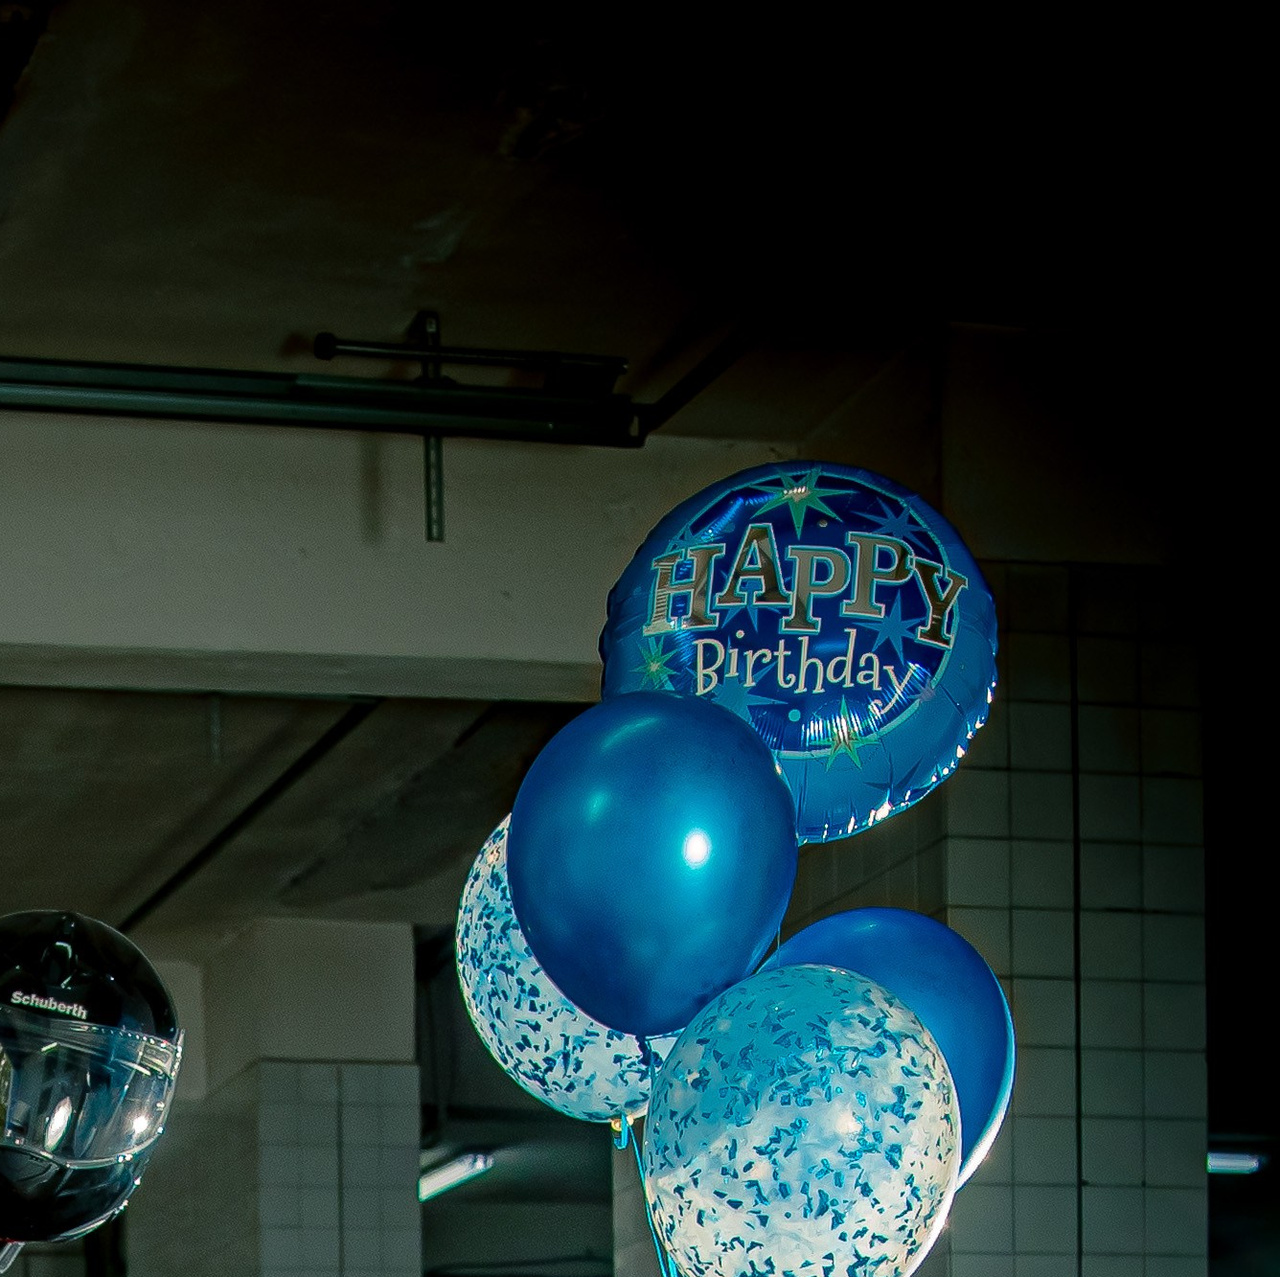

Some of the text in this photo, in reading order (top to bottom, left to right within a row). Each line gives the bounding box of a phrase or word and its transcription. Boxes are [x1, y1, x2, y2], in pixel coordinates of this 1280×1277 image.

[642, 521, 969, 650] HAPPY
[693, 628, 922, 717] Birthday
[10, 990, 89, 1020] Schuberth
